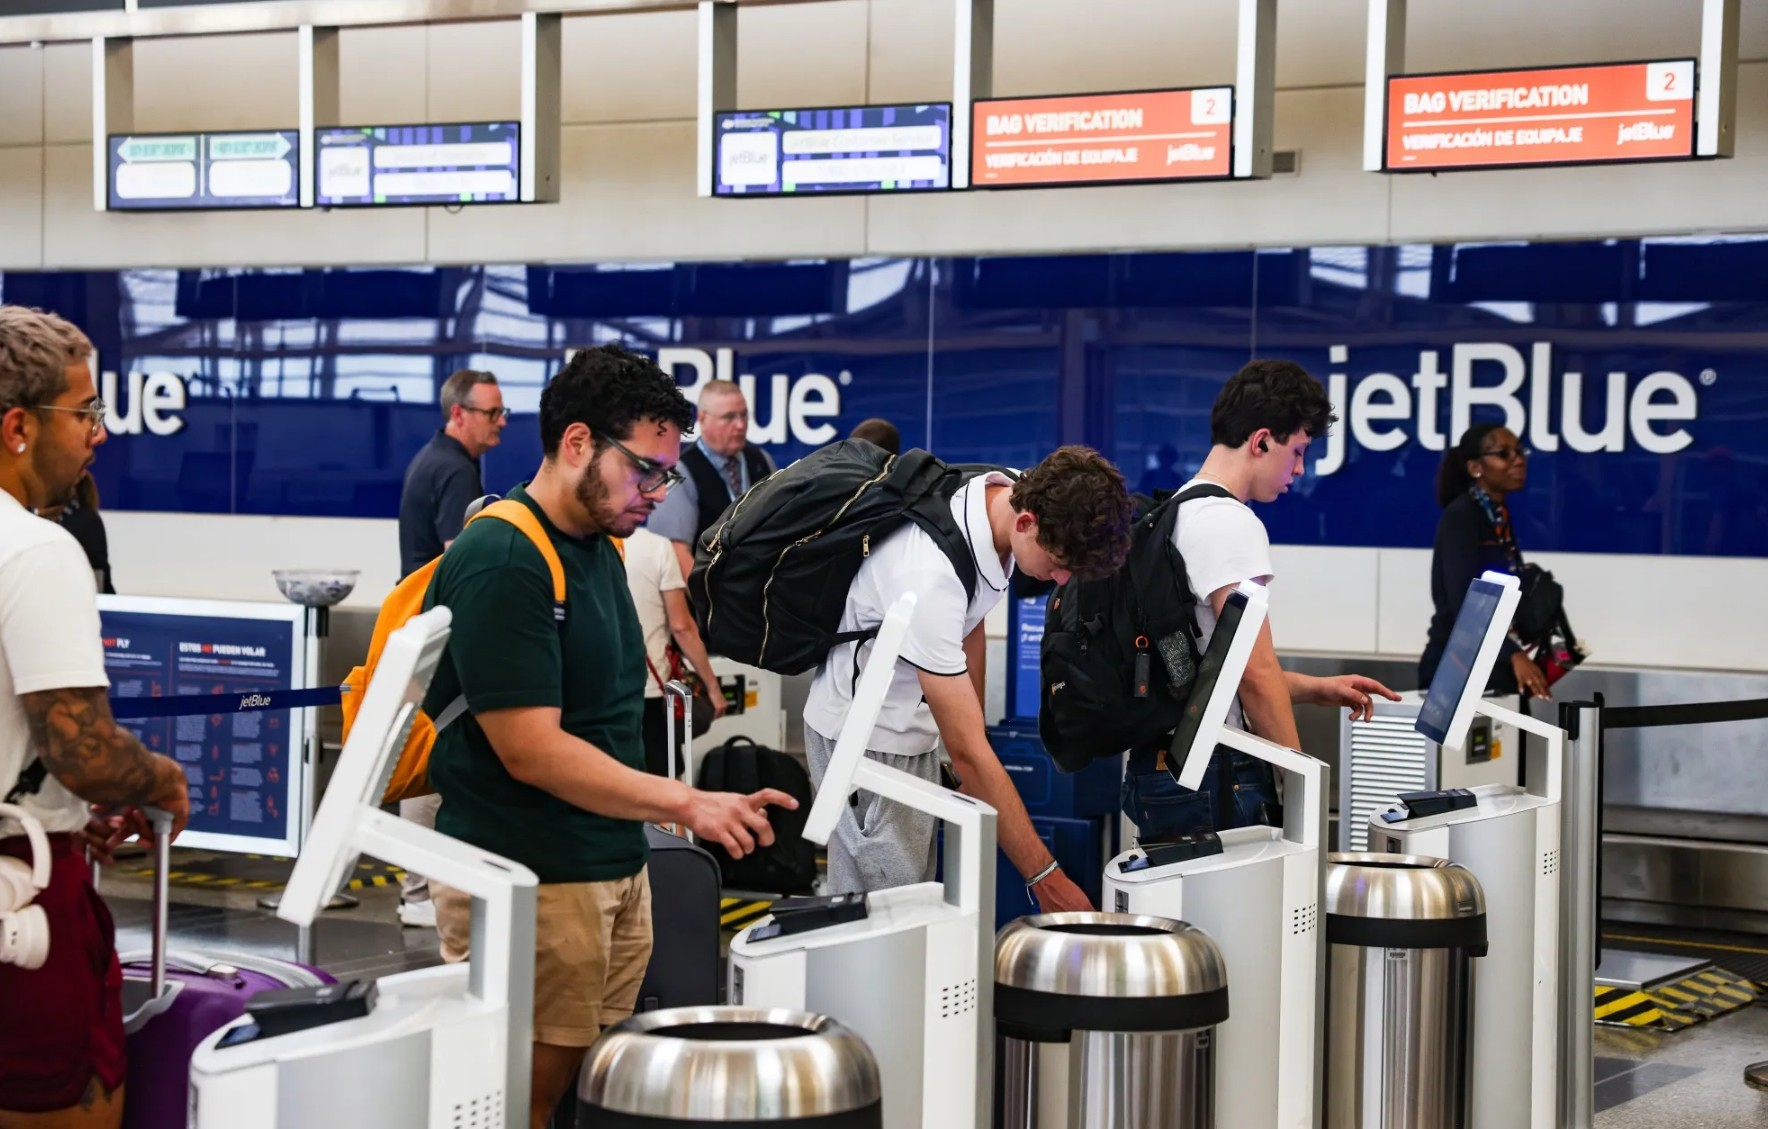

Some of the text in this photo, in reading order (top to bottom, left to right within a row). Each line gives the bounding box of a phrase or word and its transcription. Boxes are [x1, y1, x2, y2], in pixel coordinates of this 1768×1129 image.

[1663, 72, 1676, 91] 2
[1205, 98, 1216, 116] 2
[1404, 84, 1589, 115] BAG VERIFICATION
[986, 108, 1143, 135] BAG VERIFICATION
[1402, 127, 1583, 150] VERIFICACIÓN DE EQUIPAJE
[1616, 121, 1675, 145] jetBlue
[729, 150, 768, 166] jetBlue
[985, 147, 1139, 169] VERIFICACIÓN DE EQUIPAJE
[1166, 144, 1215, 165] jetBlue
[1314, 342, 1697, 476] jetBlue
[241, 645, 266, 657] VOLAR
[239, 694, 271, 710] jetBlue
